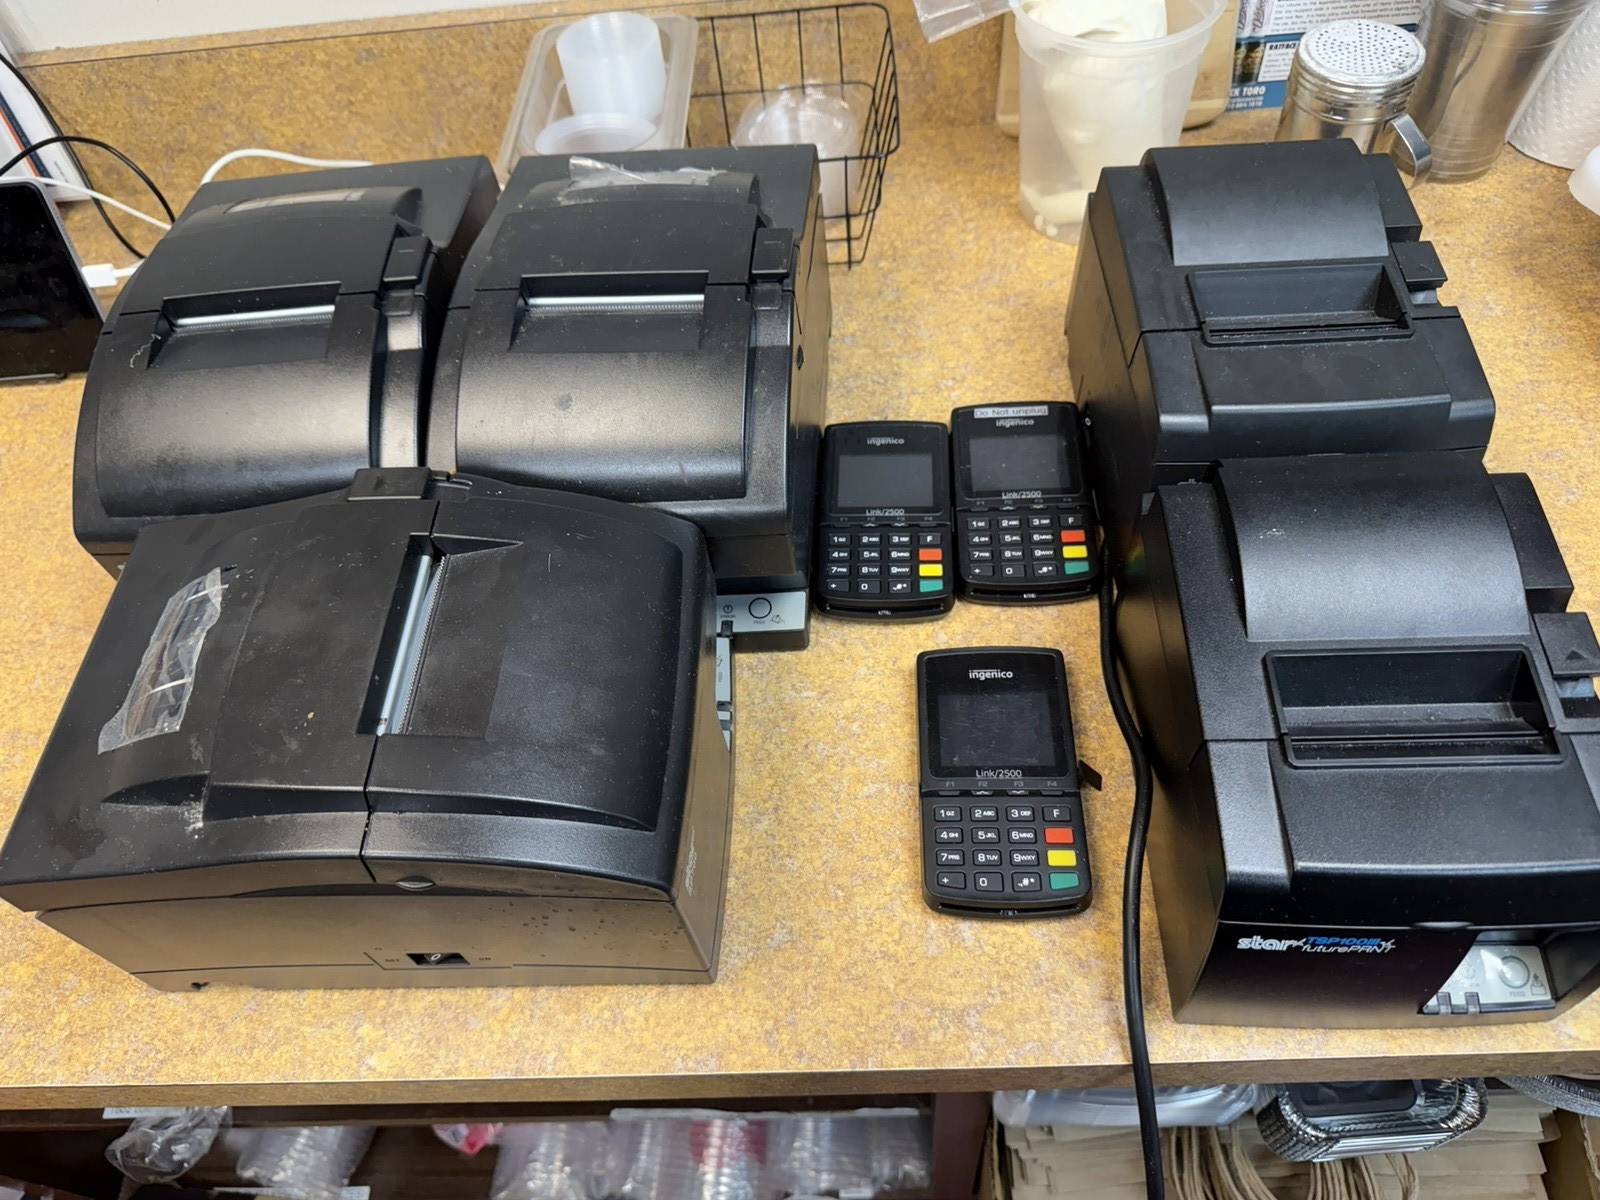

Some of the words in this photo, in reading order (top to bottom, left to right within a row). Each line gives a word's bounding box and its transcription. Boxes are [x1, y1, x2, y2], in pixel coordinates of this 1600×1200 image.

[1242, 85, 1267, 97] TORO
[974, 409, 988, 417] Do
[992, 408, 1009, 416] Not
[1012, 405, 1048, 416] unplug
[995, 418, 1035, 428] ingenico
[866, 436, 905, 447] ingenico
[1001, 490, 1042, 499] Link/2500
[865, 508, 905, 517] Link/2500
[968, 669, 1014, 680] ingenico
[975, 769, 1022, 779] Link/2500
[1236, 935, 1300, 951] star
[1508, 990, 1527, 998] FEED
